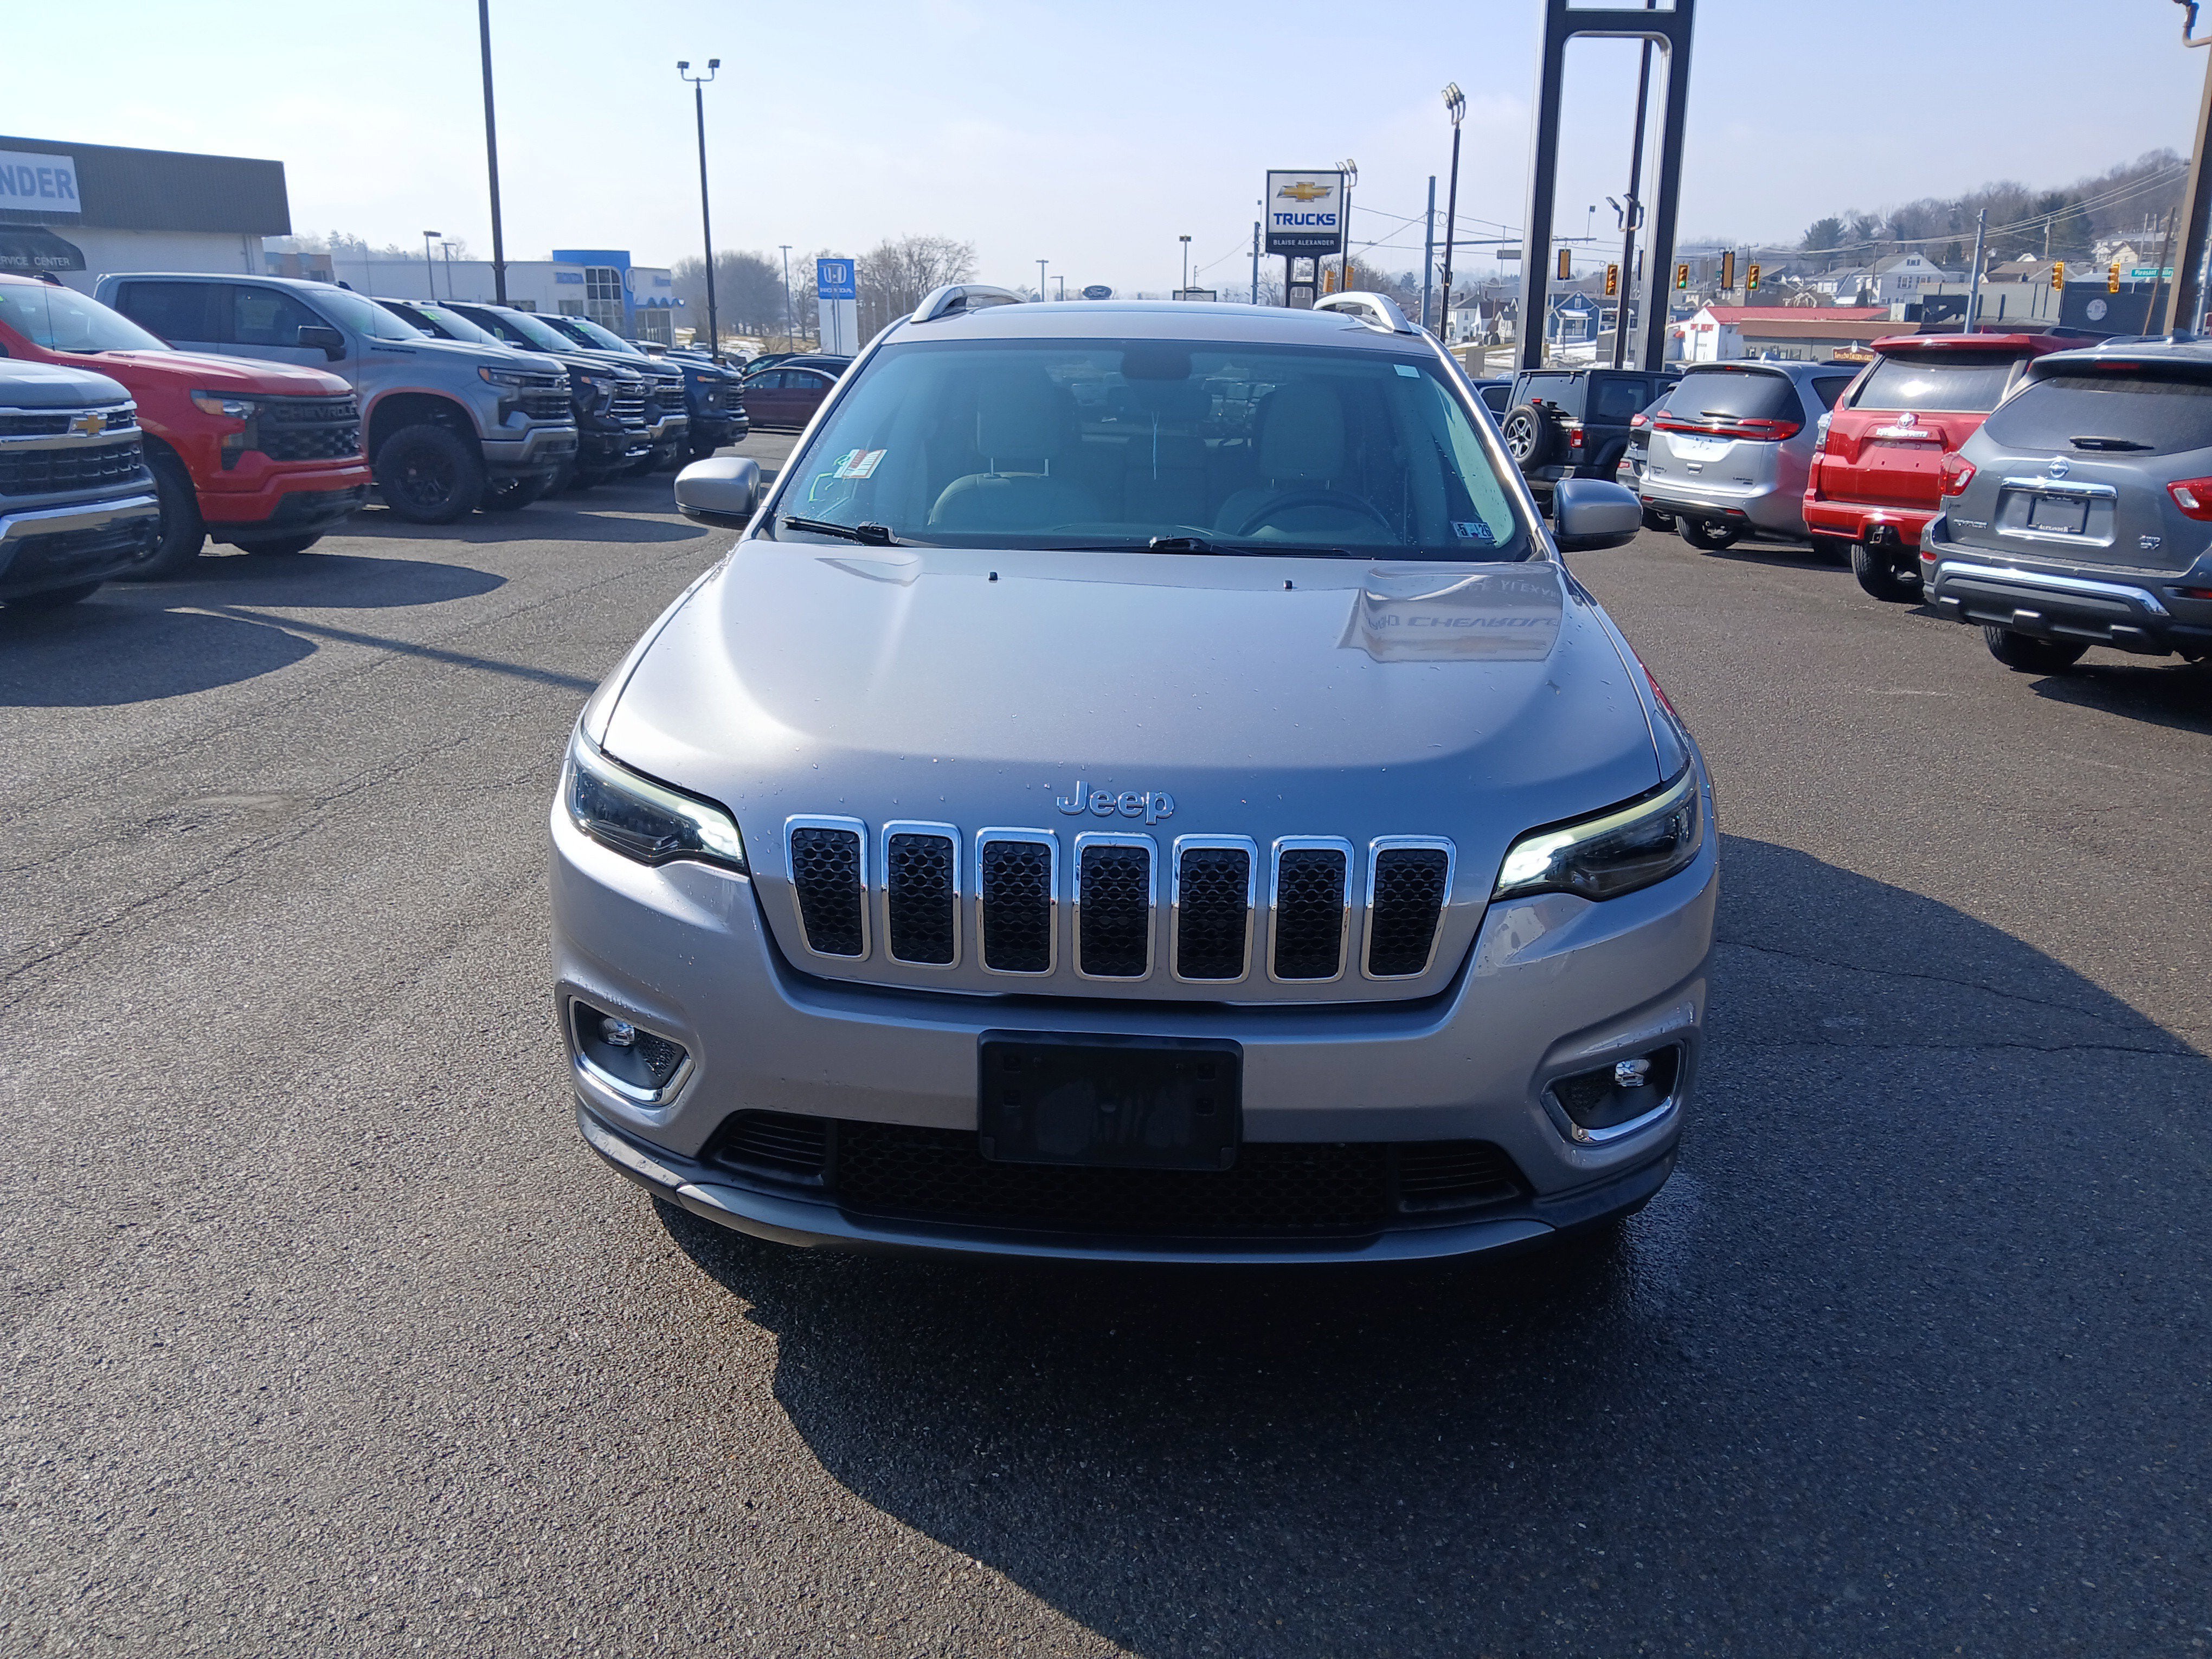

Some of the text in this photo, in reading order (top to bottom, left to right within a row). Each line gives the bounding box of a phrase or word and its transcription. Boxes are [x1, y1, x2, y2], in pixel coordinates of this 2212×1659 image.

[1273, 213, 1336, 226] TRUCKS
[34, 256, 70, 266] CENTER
[1457, 523, 1491, 537] 5 26
[1057, 781, 1175, 825] Jeep
